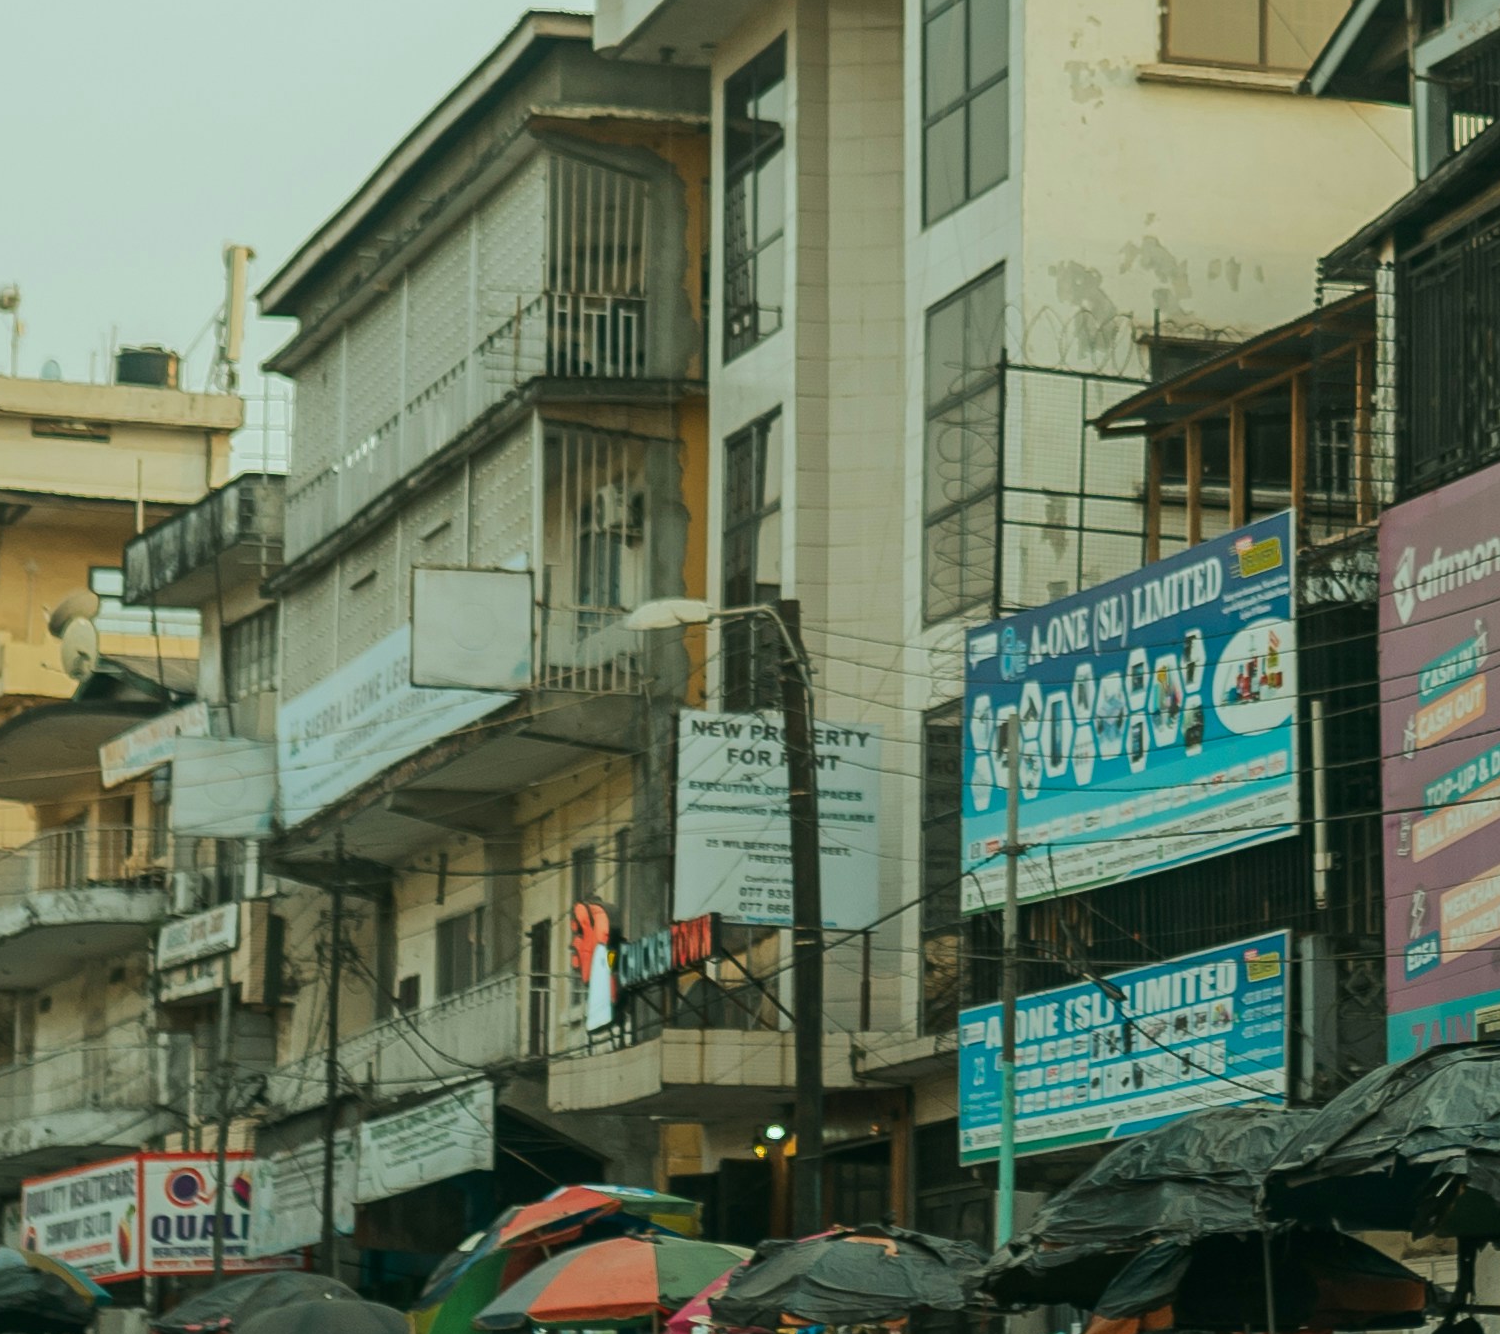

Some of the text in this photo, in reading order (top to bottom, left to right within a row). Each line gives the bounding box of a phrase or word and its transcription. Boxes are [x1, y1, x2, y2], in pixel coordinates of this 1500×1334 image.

[1093, 594, 1130, 657] (SL)
[1131, 556, 1223, 629] LIMITED
[1420, 659, 1457, 696] CASH
[1417, 683, 1484, 742] CASH OUT
[691, 720, 870, 748] NEW PRERTY
[727, 747, 841, 771] FOR RNT
[747, 854, 792, 865] FREETO
[739, 886, 764, 897] 077
[985, 1002, 1059, 1050] AONE
[1126, 959, 1239, 1017] LIMITED
